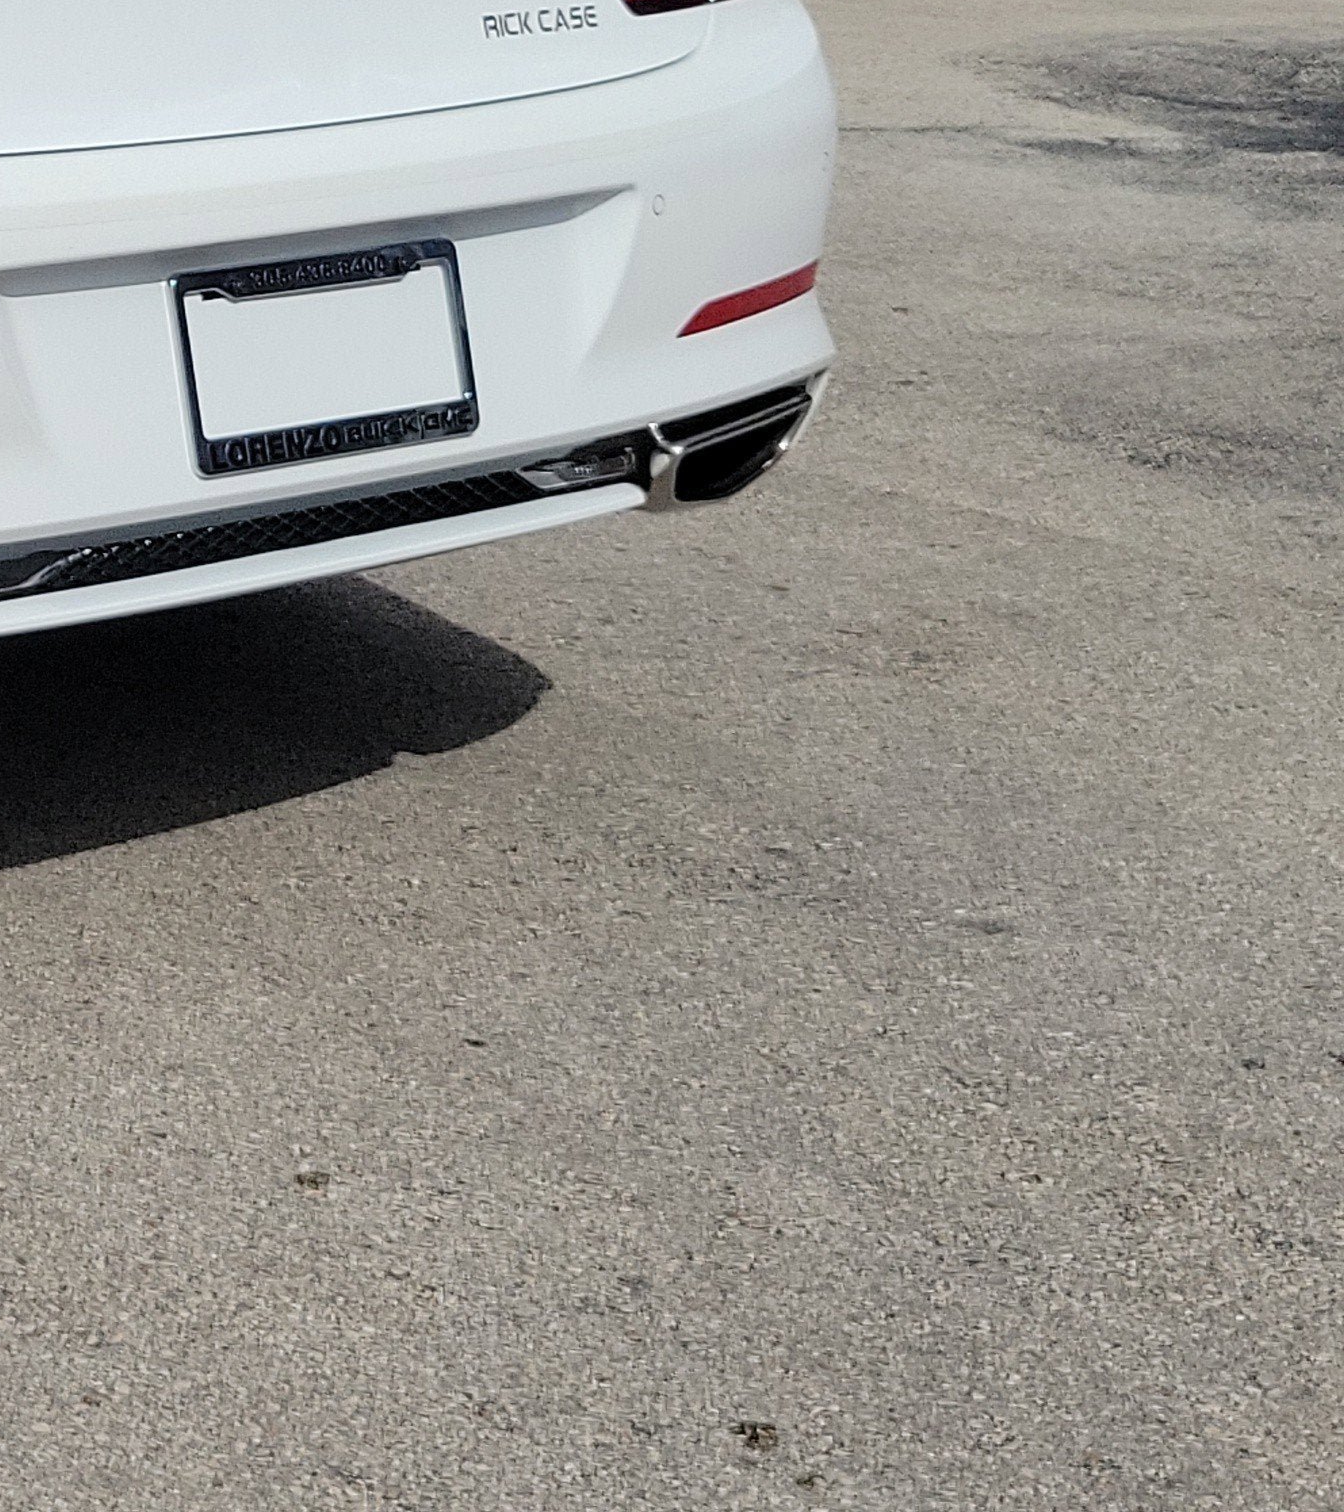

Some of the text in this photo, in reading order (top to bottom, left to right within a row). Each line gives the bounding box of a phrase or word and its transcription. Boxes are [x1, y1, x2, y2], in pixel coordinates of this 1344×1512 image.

[482, 5, 599, 39] RICK CASE
[209, 426, 342, 469] LORENZO
